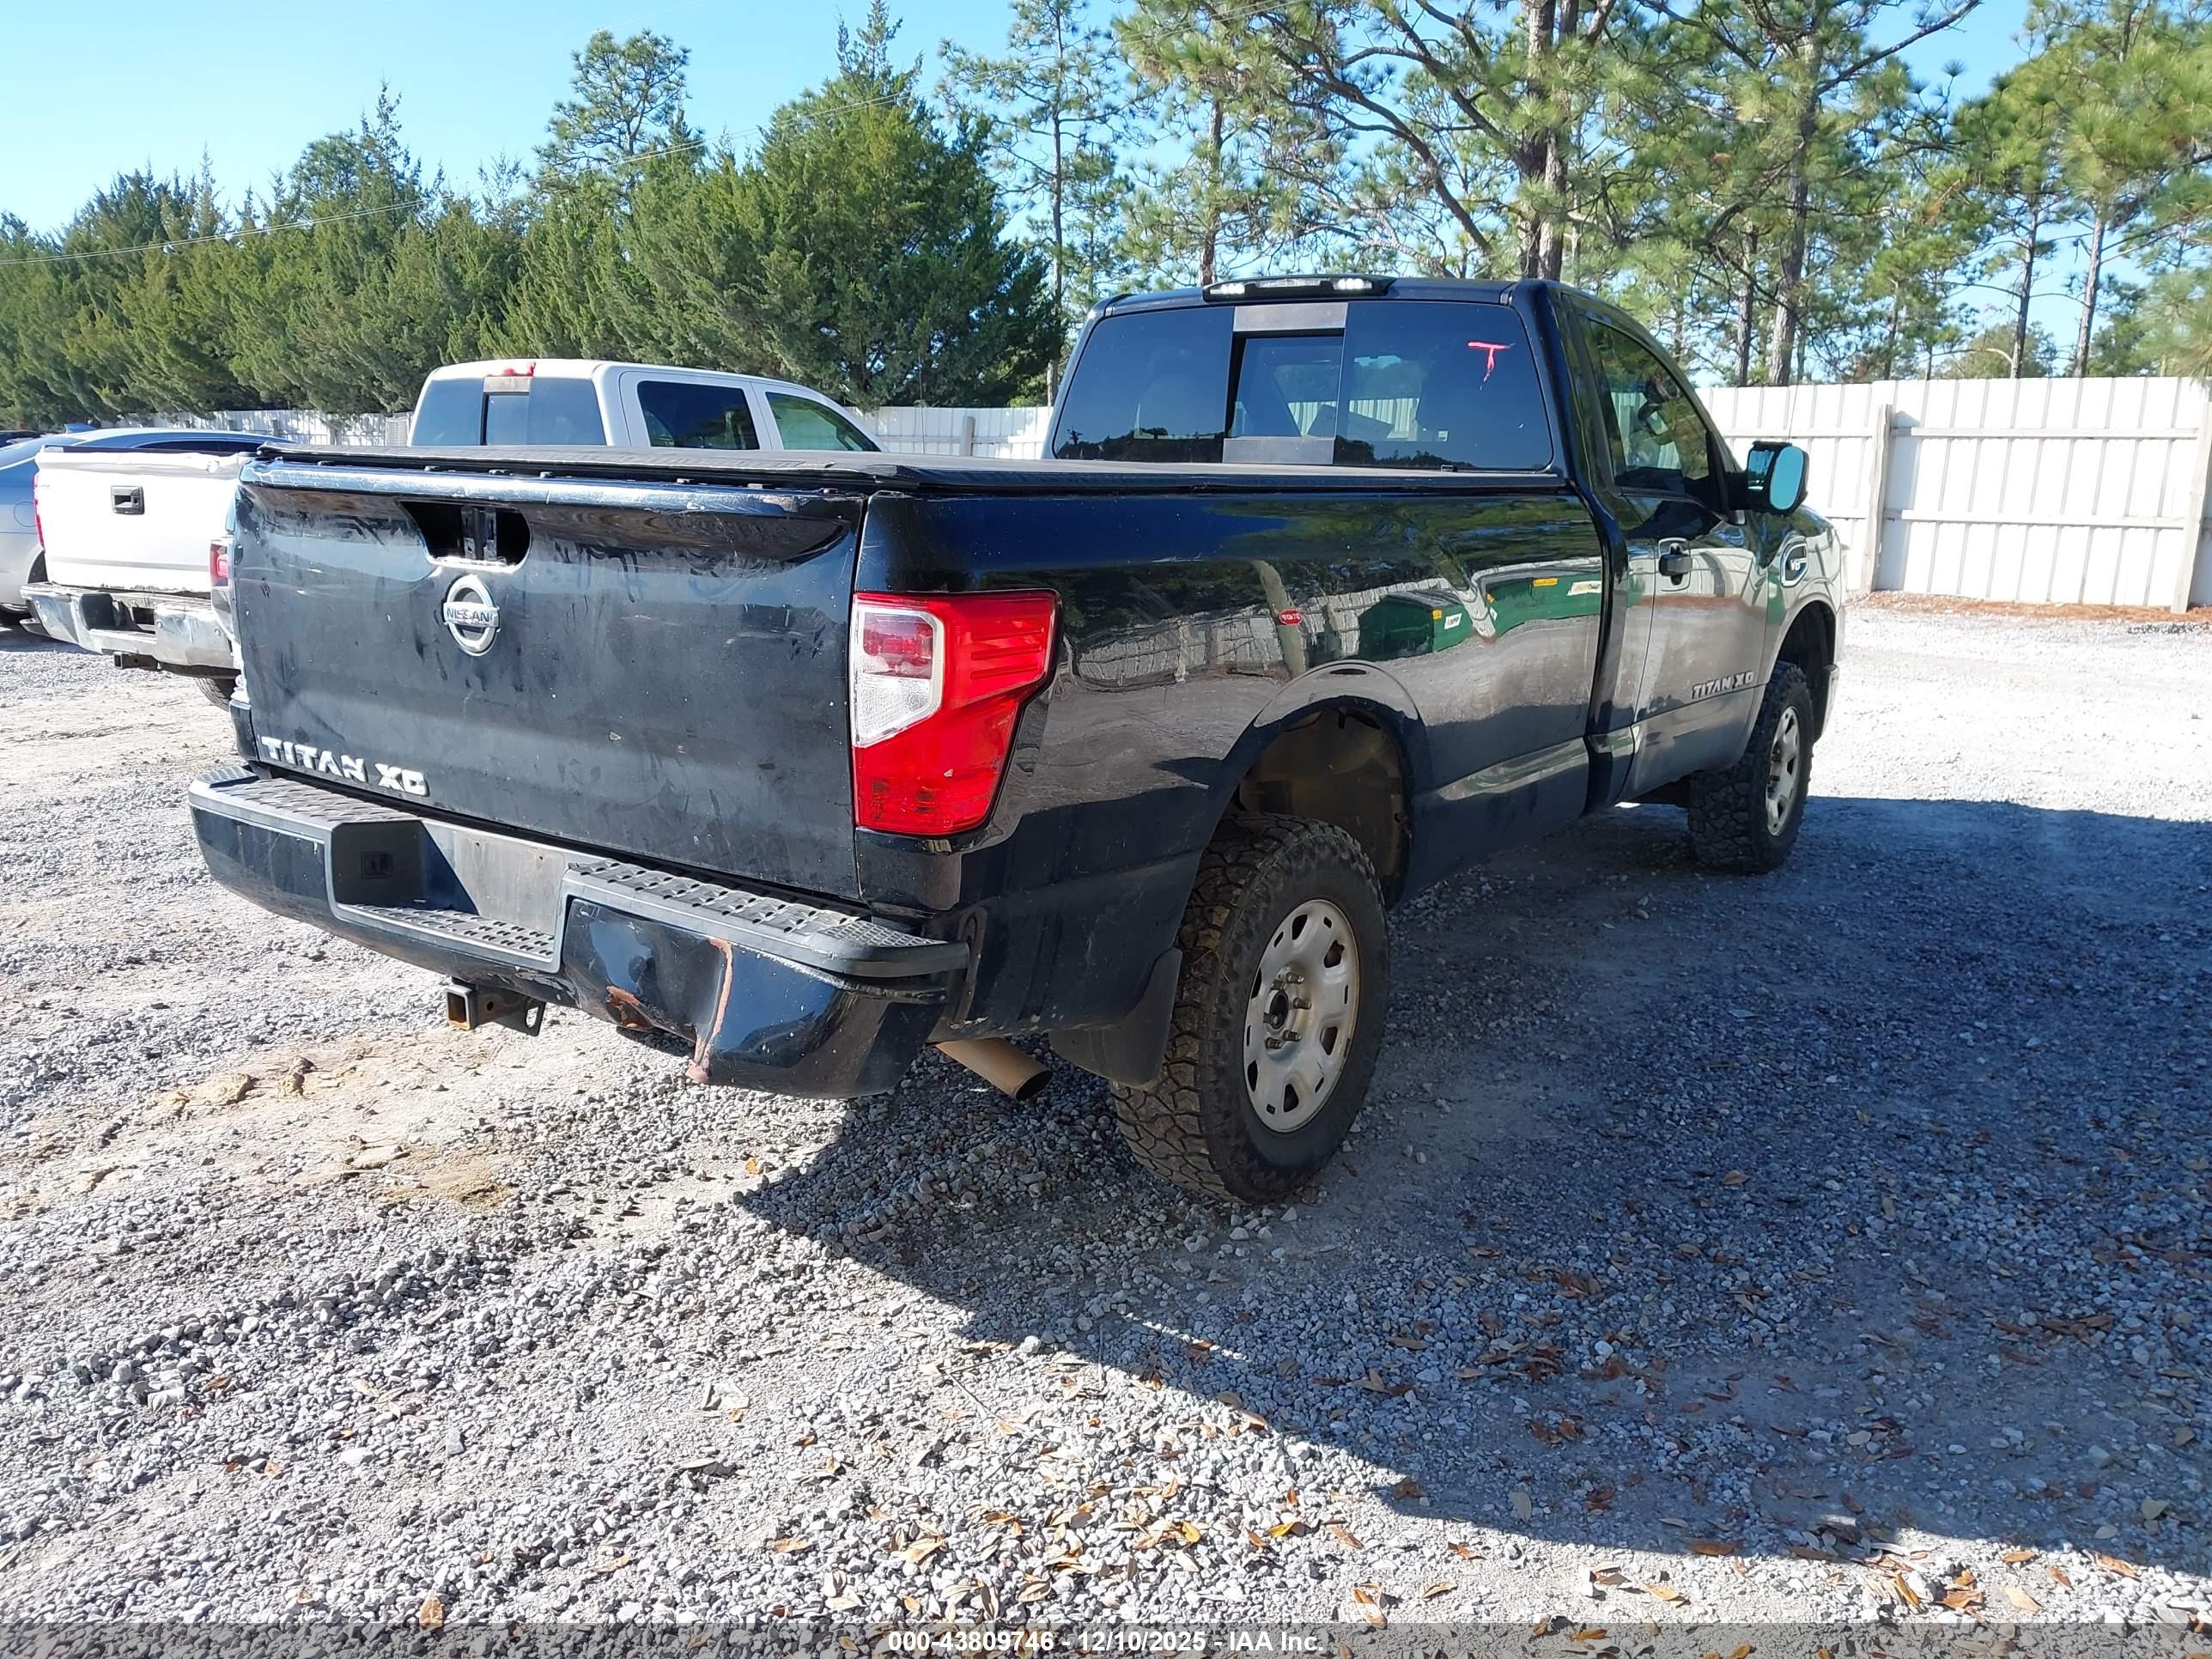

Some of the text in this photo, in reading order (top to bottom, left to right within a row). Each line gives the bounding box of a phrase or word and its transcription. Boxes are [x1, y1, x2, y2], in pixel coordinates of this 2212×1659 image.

[1468, 341, 1516, 390] T
[447, 607, 489, 623] NISSAN
[1691, 671, 1754, 699] TITAN XD
[261, 736, 430, 798] TITAN XD
